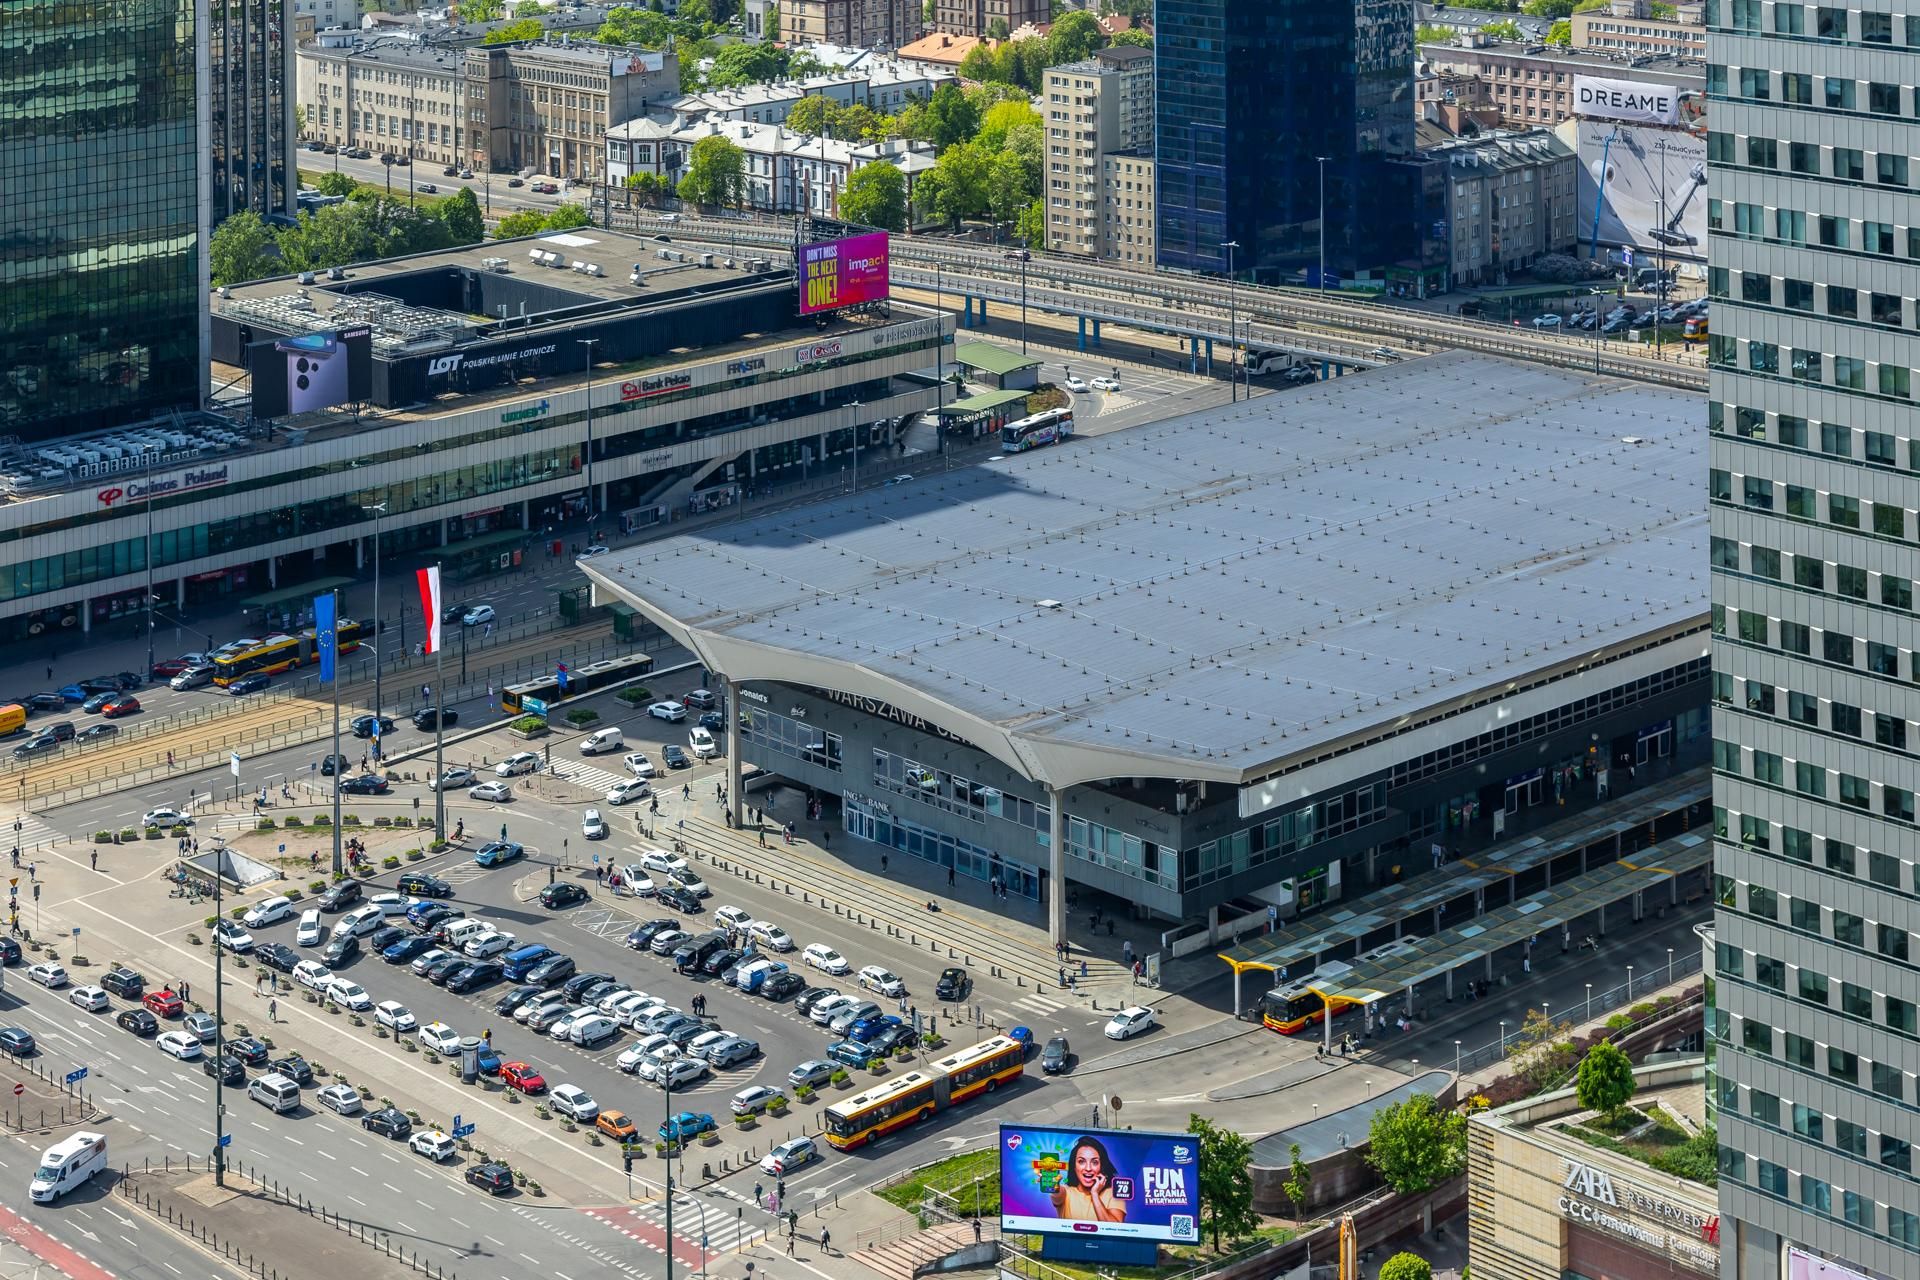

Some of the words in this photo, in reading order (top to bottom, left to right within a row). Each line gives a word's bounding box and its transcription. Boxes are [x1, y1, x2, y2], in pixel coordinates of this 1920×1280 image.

[1580, 87, 1669, 113] DREAME
[806, 248, 822, 261] DON'T
[823, 245, 838, 258] MISS
[849, 254, 885, 271] impact
[807, 262, 819, 278] THE
[820, 259, 838, 275] NEXT
[807, 275, 838, 307] ONE!
[343, 329, 370, 339] SAMSUNG
[428, 354, 464, 376] LOT
[462, 356, 495, 369] POLSKIE
[497, 352, 518, 362] LINIE
[519, 344, 557, 358] LOTNICZE
[642, 379, 663, 391] Bank
[664, 375, 690, 388] Pekao
[127, 480, 178, 498] Casinos
[184, 465, 228, 486] Poland
[828, 688, 927, 730] WARSZAWA
[843, 789, 858, 801] ING
[868, 798, 889, 812] BANK
[1117, 1185, 1129, 1193] 70
[1142, 1166, 1185, 1190] FUN
[1563, 1162, 1619, 1207] ZARA
[1153, 1189, 1186, 1198] GRANIA
[1557, 1196, 1593, 1222] CCC
[1627, 1190, 1701, 1229] RESERVED
[1600, 1213, 1665, 1249] STRADIVARIUS
[1670, 1235, 1717, 1264] Carrefour
